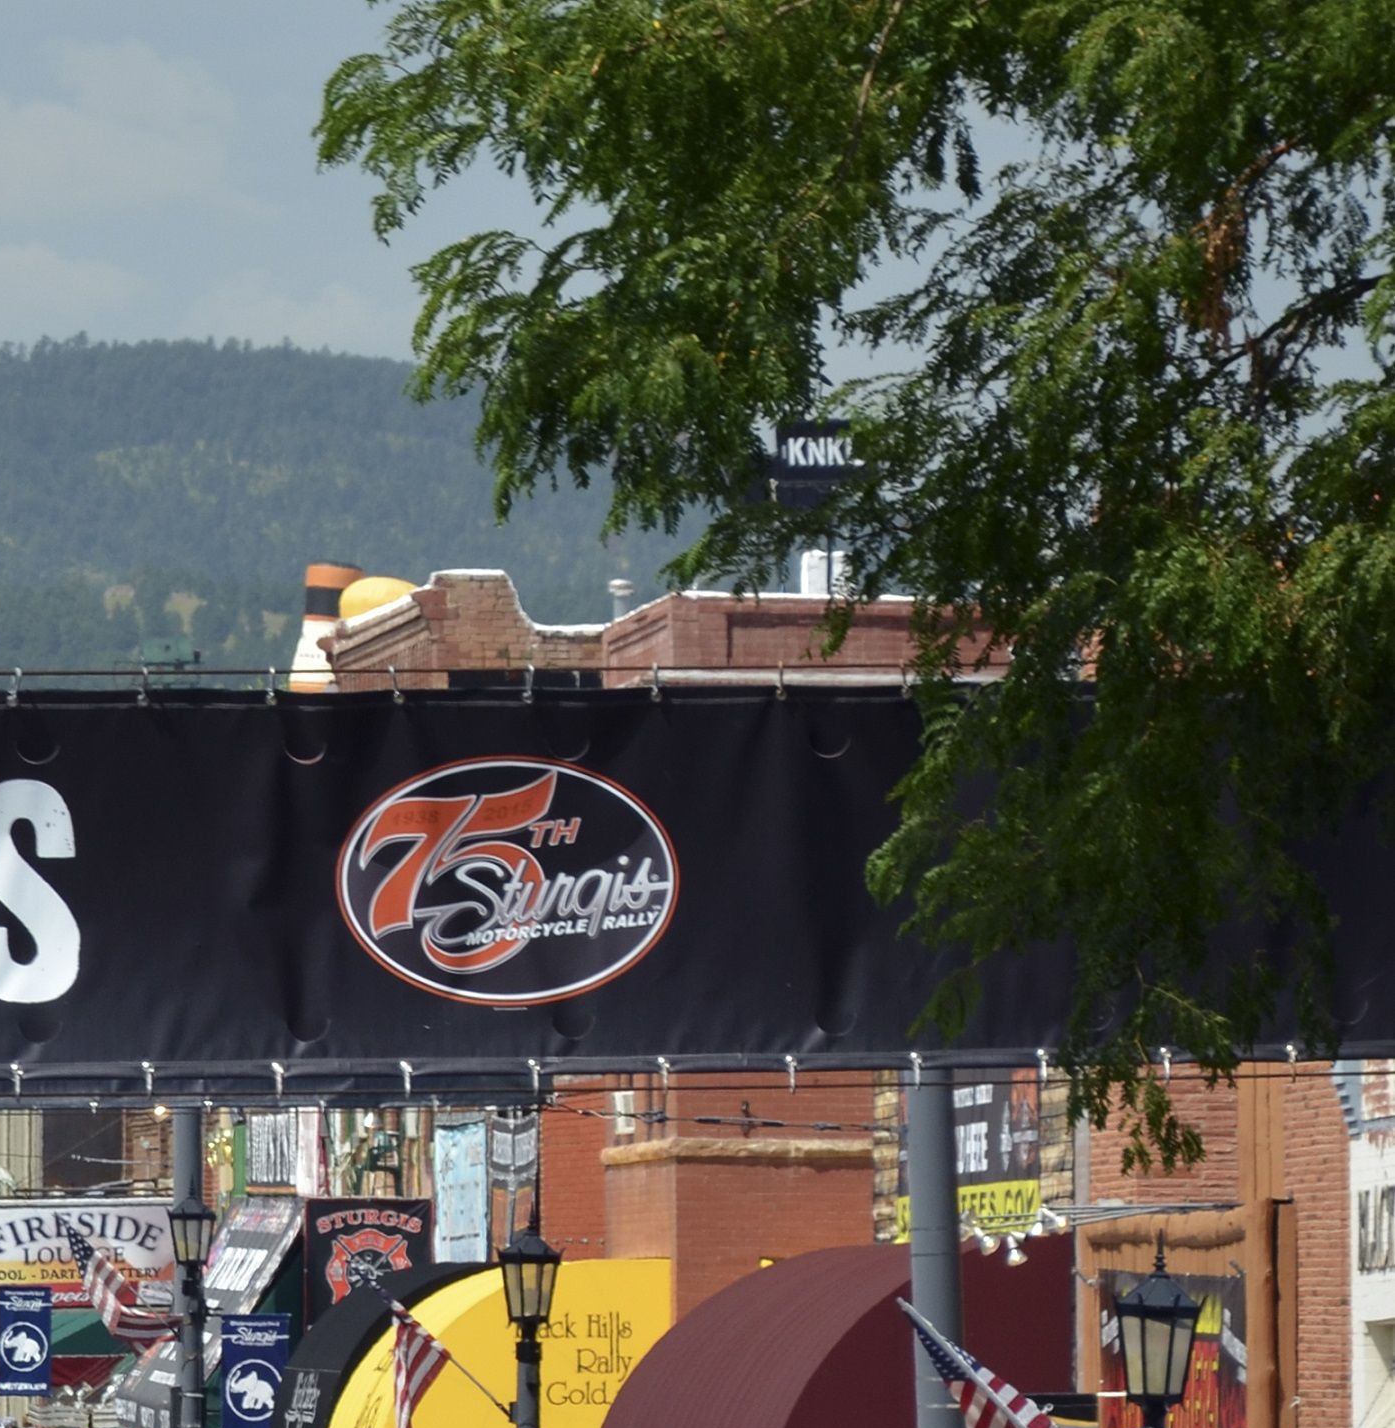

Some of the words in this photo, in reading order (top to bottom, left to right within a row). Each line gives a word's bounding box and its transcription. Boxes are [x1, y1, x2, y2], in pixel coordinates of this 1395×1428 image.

[421, 856, 665, 943] Sturgis
[466, 920, 589, 946] MOTORCYCLE
[602, 911, 658, 930] RALLY
[316, 1209, 423, 1234] STURGIS
[23, 1247, 125, 1265] LOUGE
[587, 1312, 633, 1339] Hills
[577, 1347, 633, 1383] Rally
[546, 1381, 611, 1406] Gold
